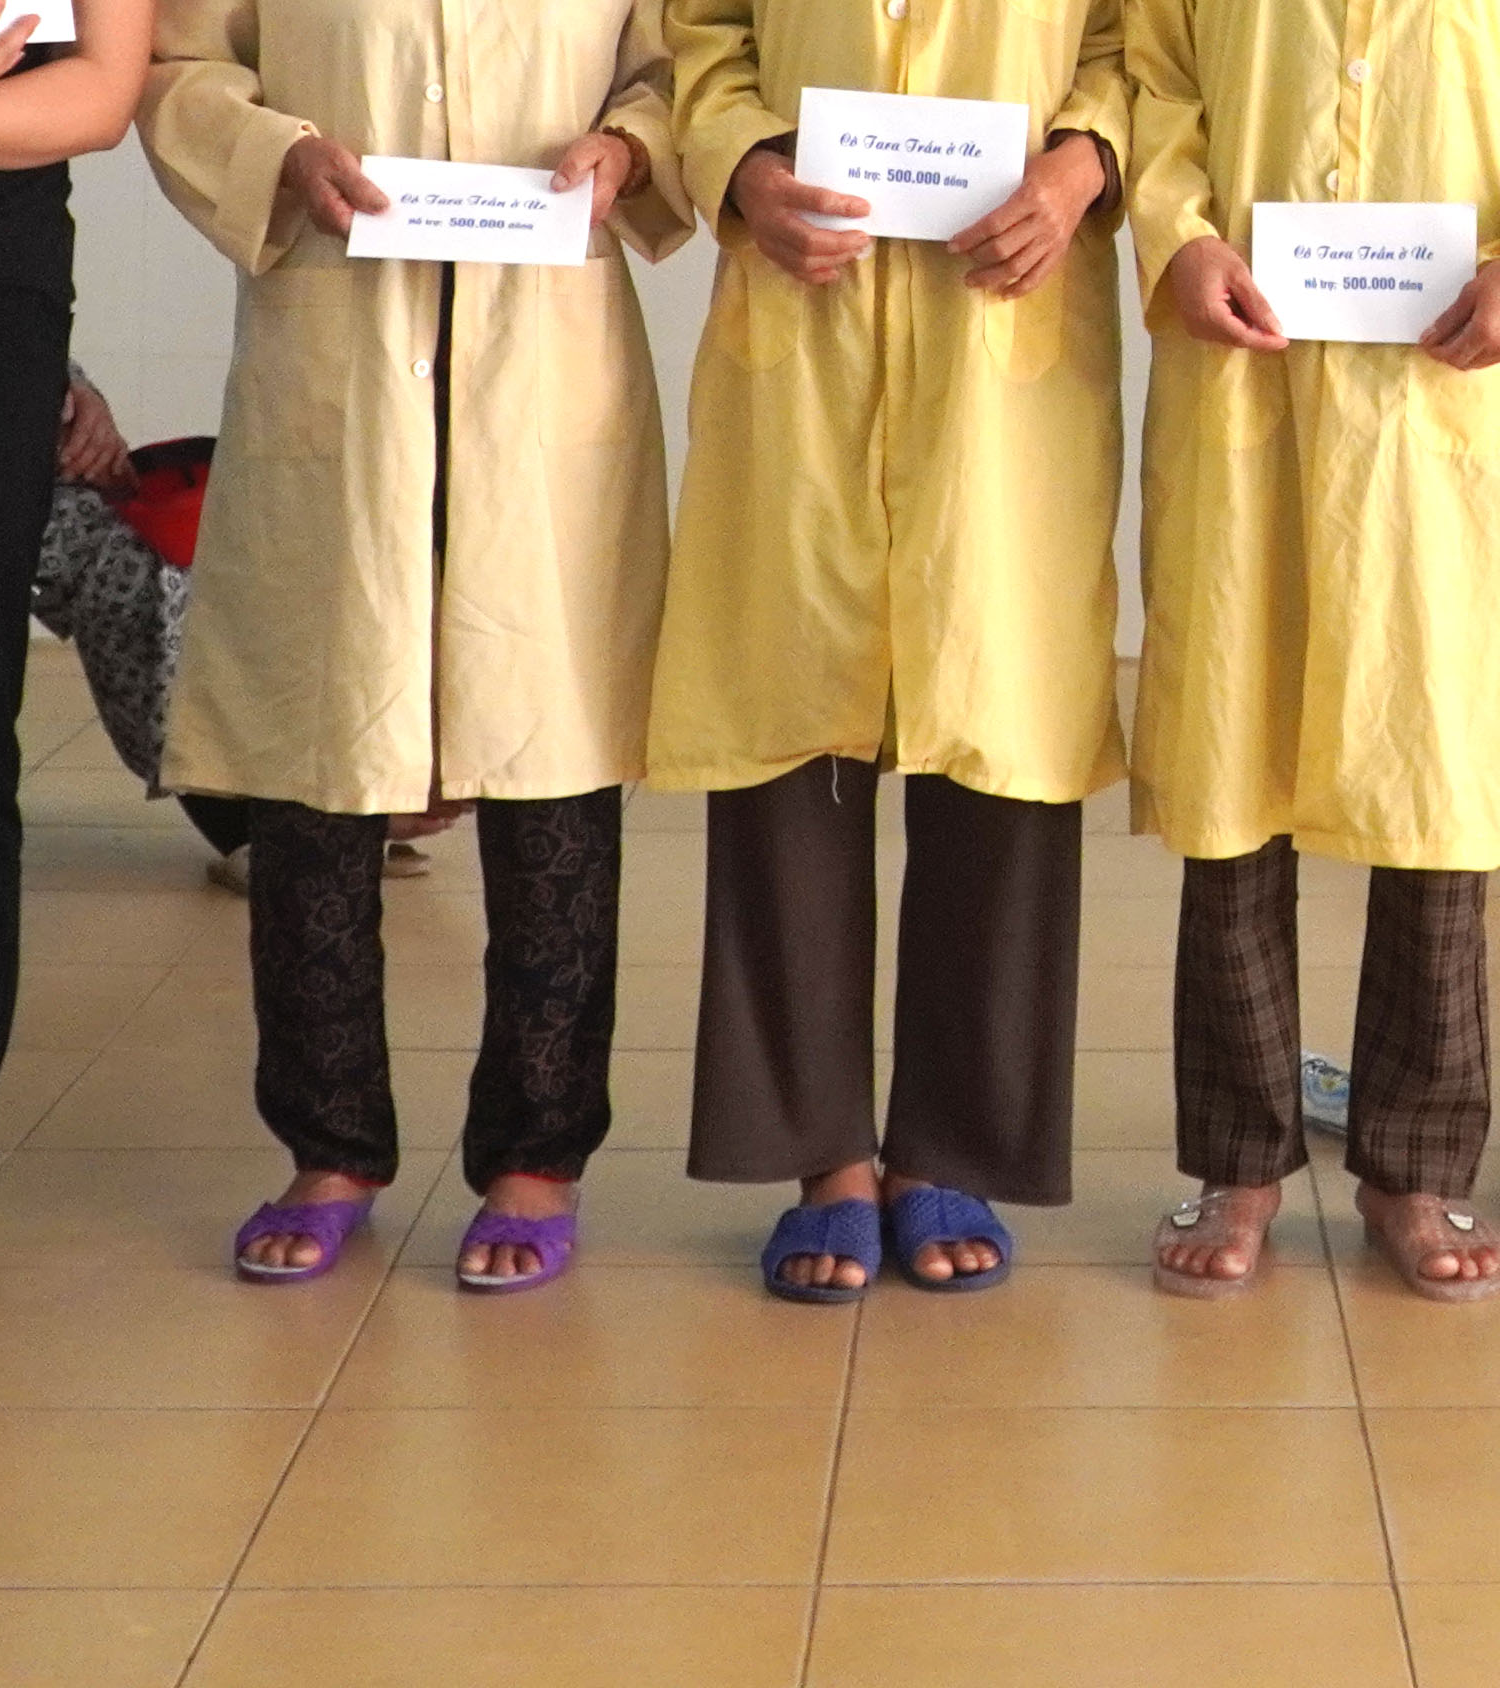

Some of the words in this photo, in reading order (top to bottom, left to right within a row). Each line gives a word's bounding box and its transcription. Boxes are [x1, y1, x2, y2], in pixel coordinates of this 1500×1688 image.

[862, 134, 901, 152] Tara
[886, 167, 942, 186] 500.000
[449, 216, 506, 230] 500.000
[1316, 244, 1354, 261] Tara
[1343, 276, 1397, 291] 500.000
